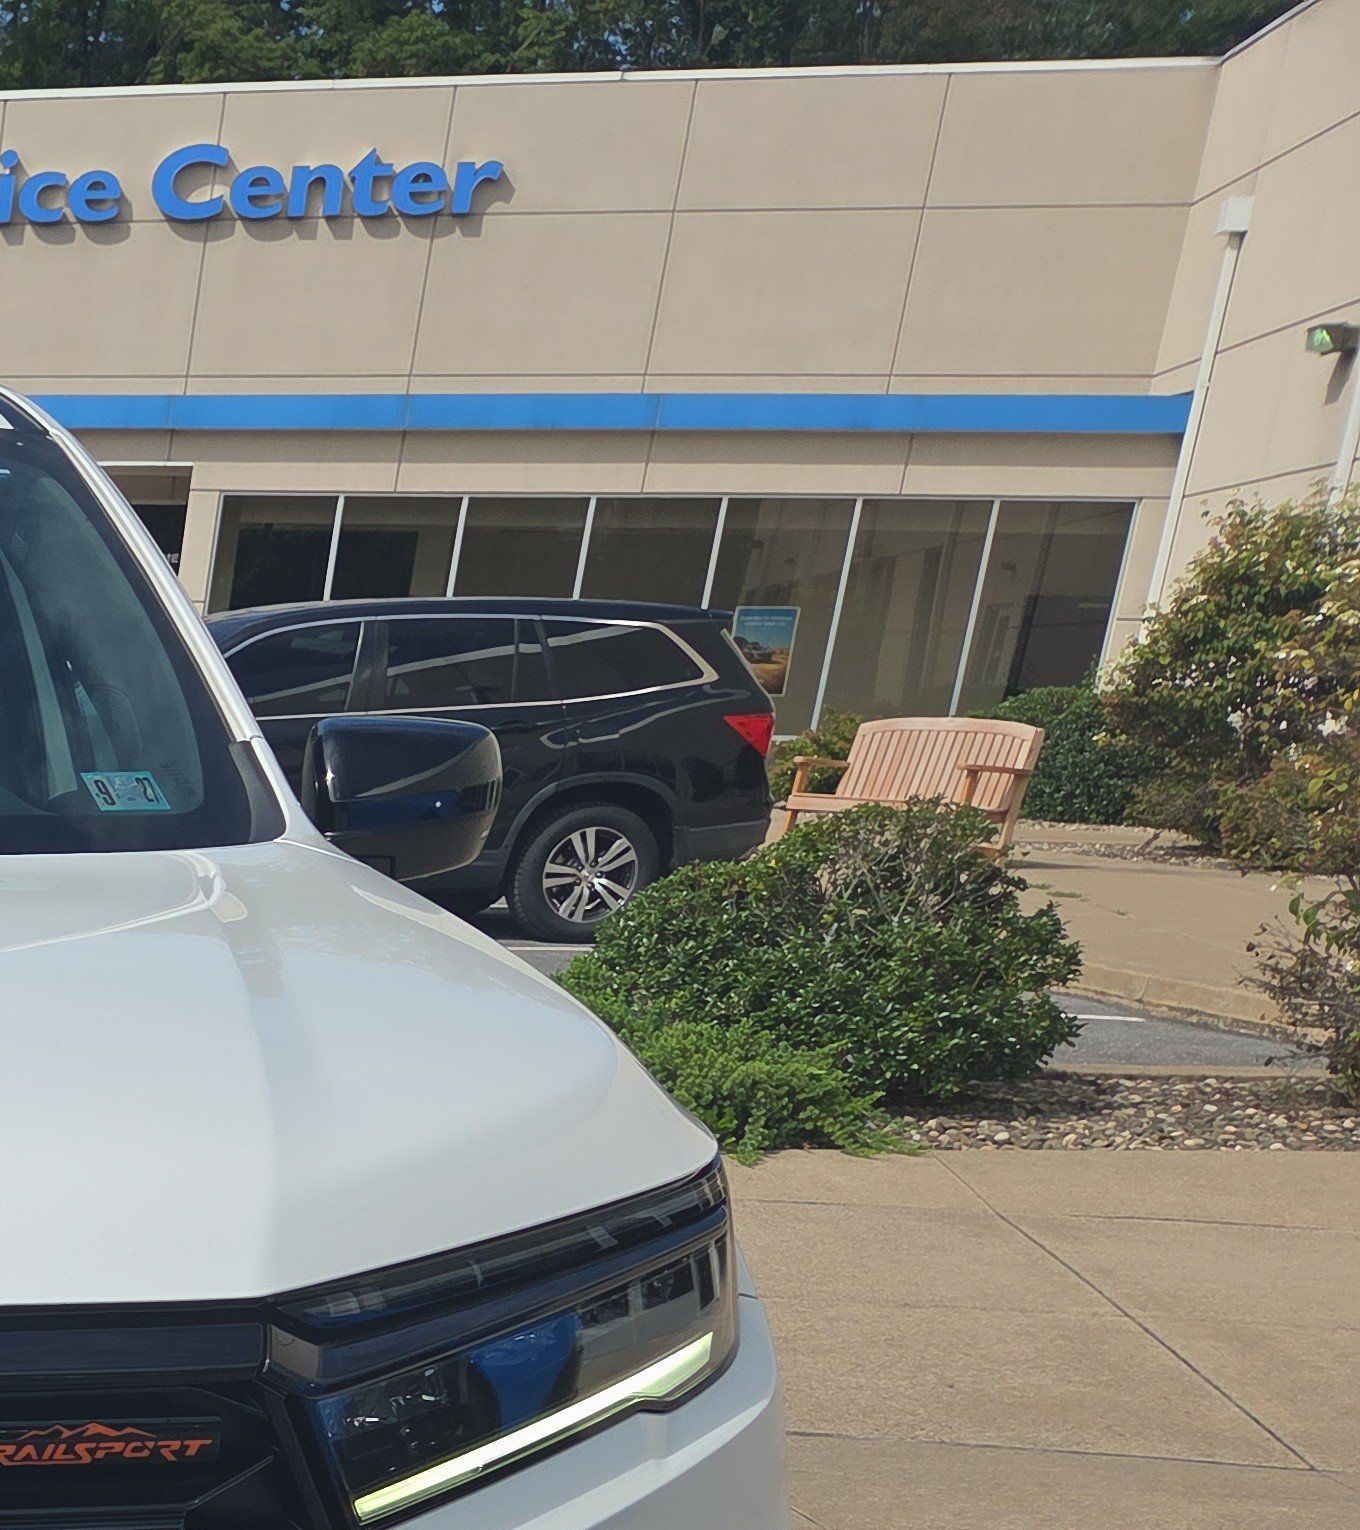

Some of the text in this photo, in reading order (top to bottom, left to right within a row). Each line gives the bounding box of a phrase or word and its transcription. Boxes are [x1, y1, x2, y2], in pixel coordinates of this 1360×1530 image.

[151, 143, 504, 221] Center
[93, 776, 160, 806] 9 27
